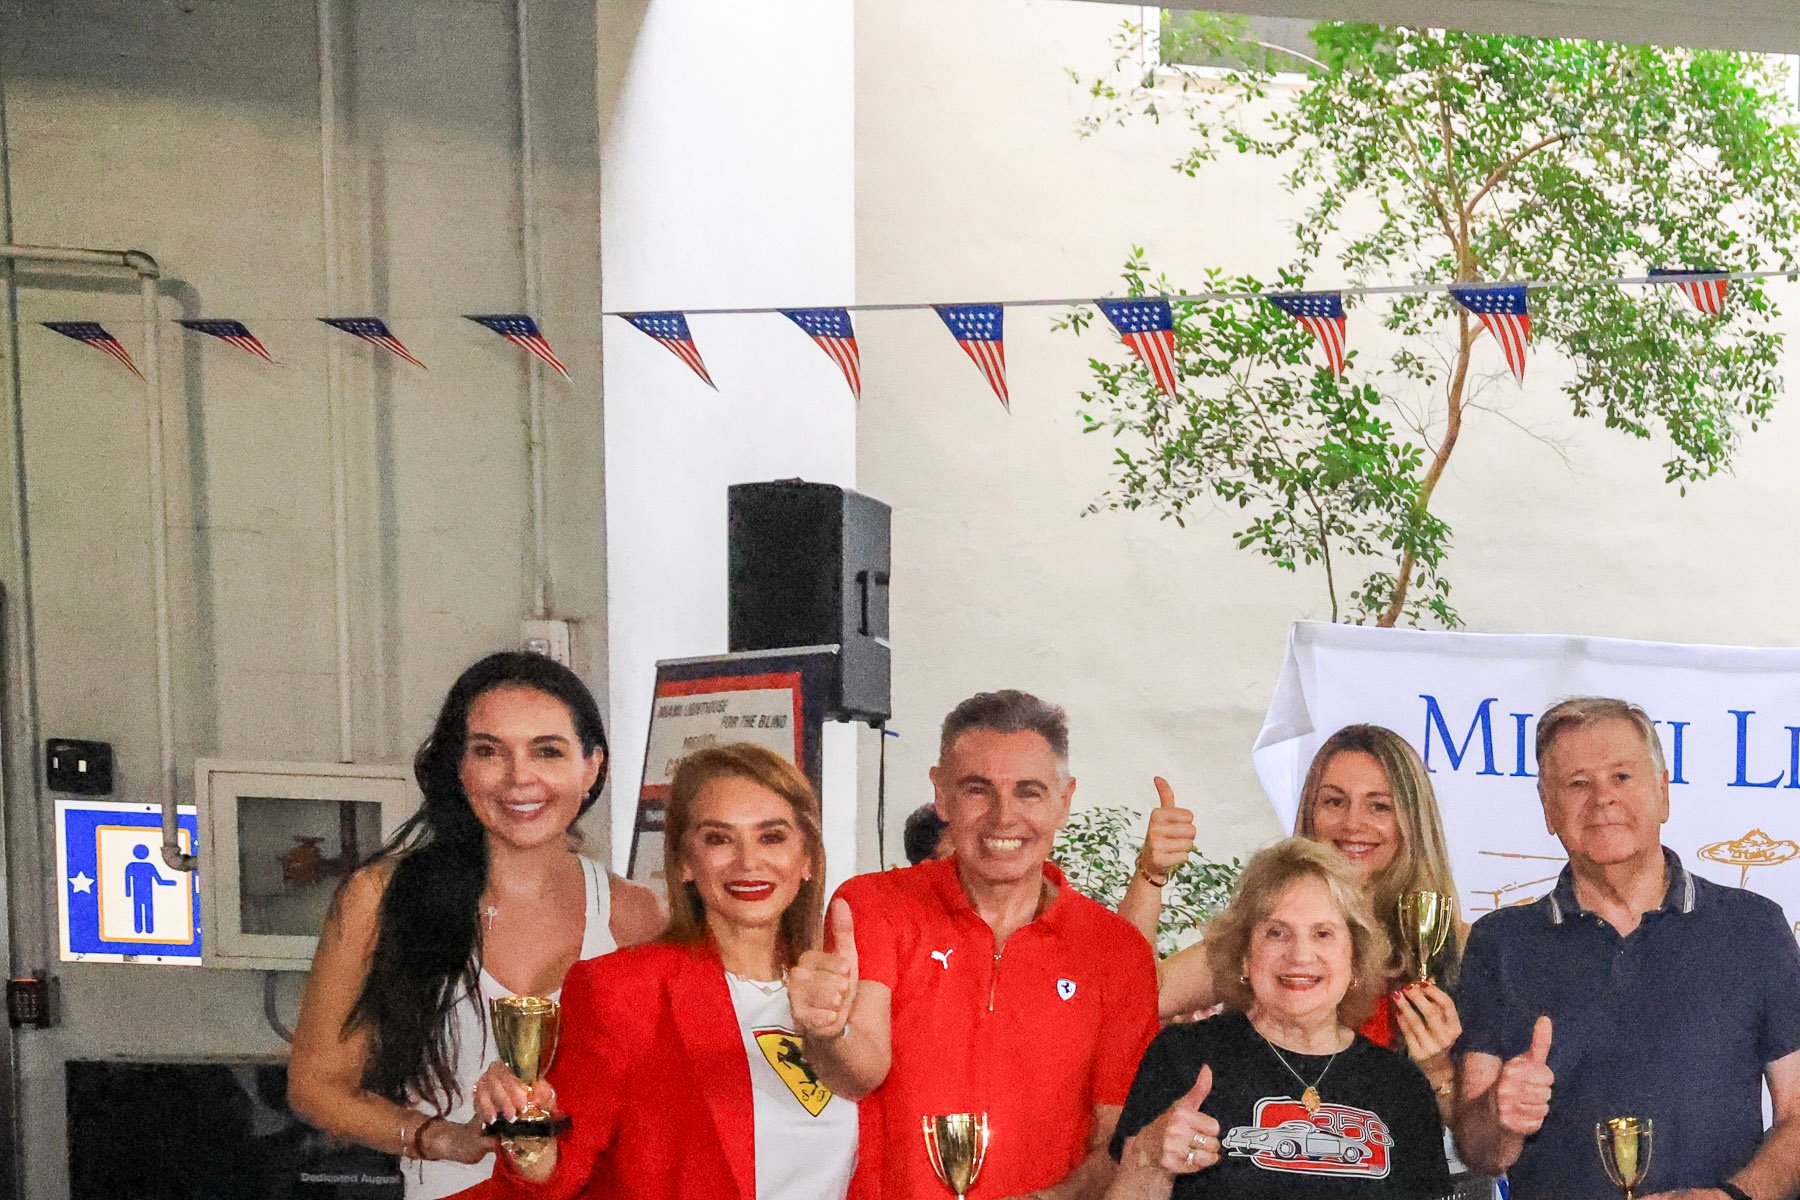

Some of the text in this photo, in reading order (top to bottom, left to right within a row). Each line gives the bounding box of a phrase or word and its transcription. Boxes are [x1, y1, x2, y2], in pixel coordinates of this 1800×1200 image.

[757, 714, 788, 729] BLIND
[1418, 694, 1691, 785] MII
[1311, 1108, 1395, 1147] 356
